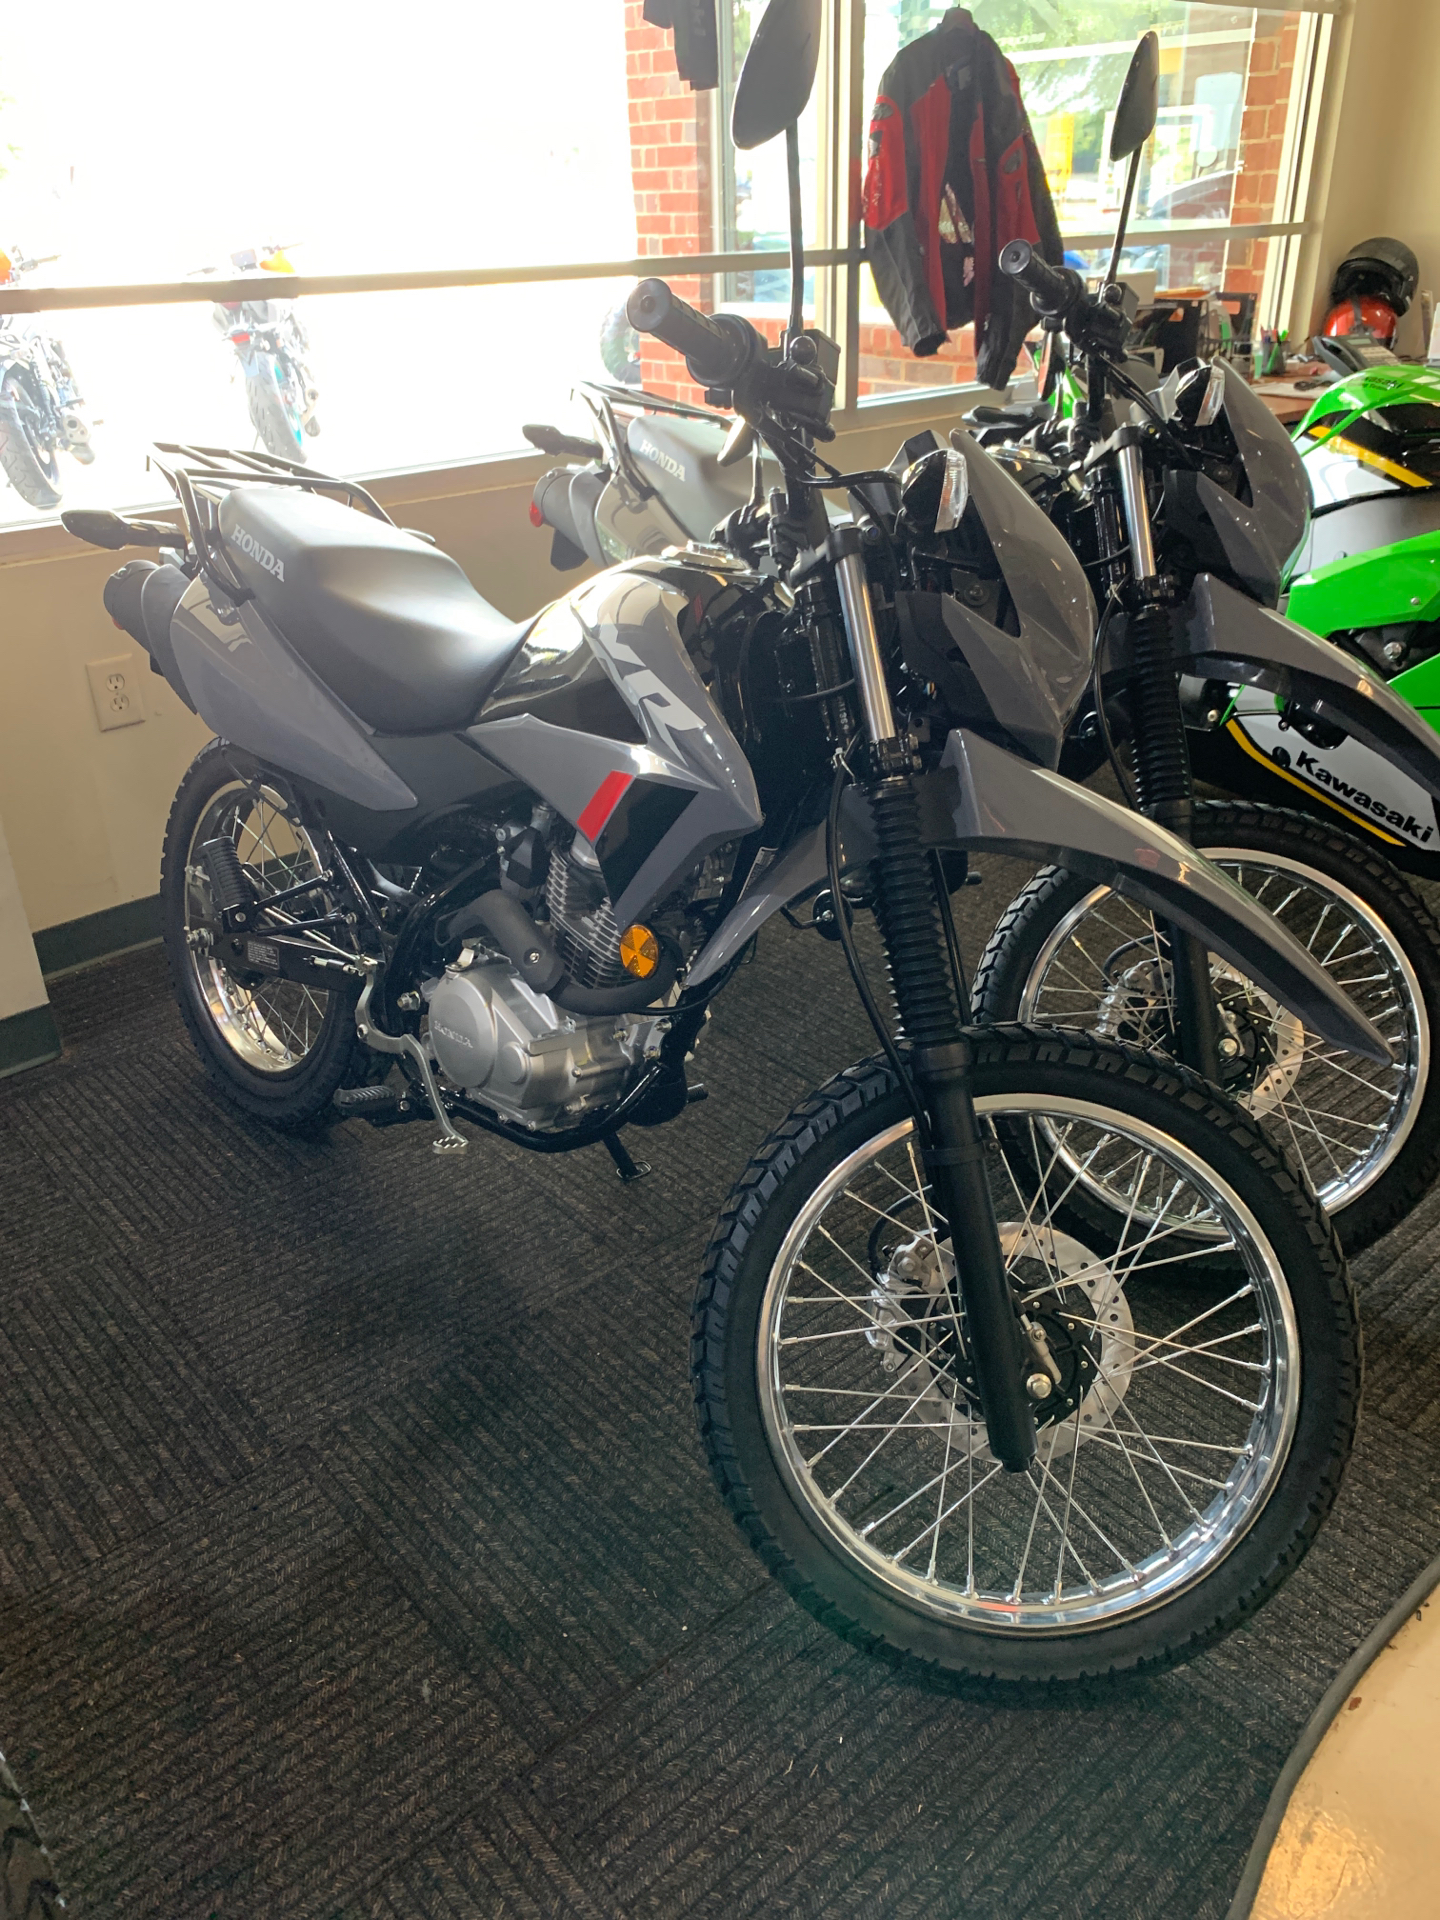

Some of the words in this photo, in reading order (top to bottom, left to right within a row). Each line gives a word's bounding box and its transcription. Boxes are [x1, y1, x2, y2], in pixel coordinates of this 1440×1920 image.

[639, 439, 686, 482] HONDA
[230, 523, 285, 583] HONDA
[1295, 750, 1434, 843] Kawasaki
[434, 1020, 474, 1049] HONDA
